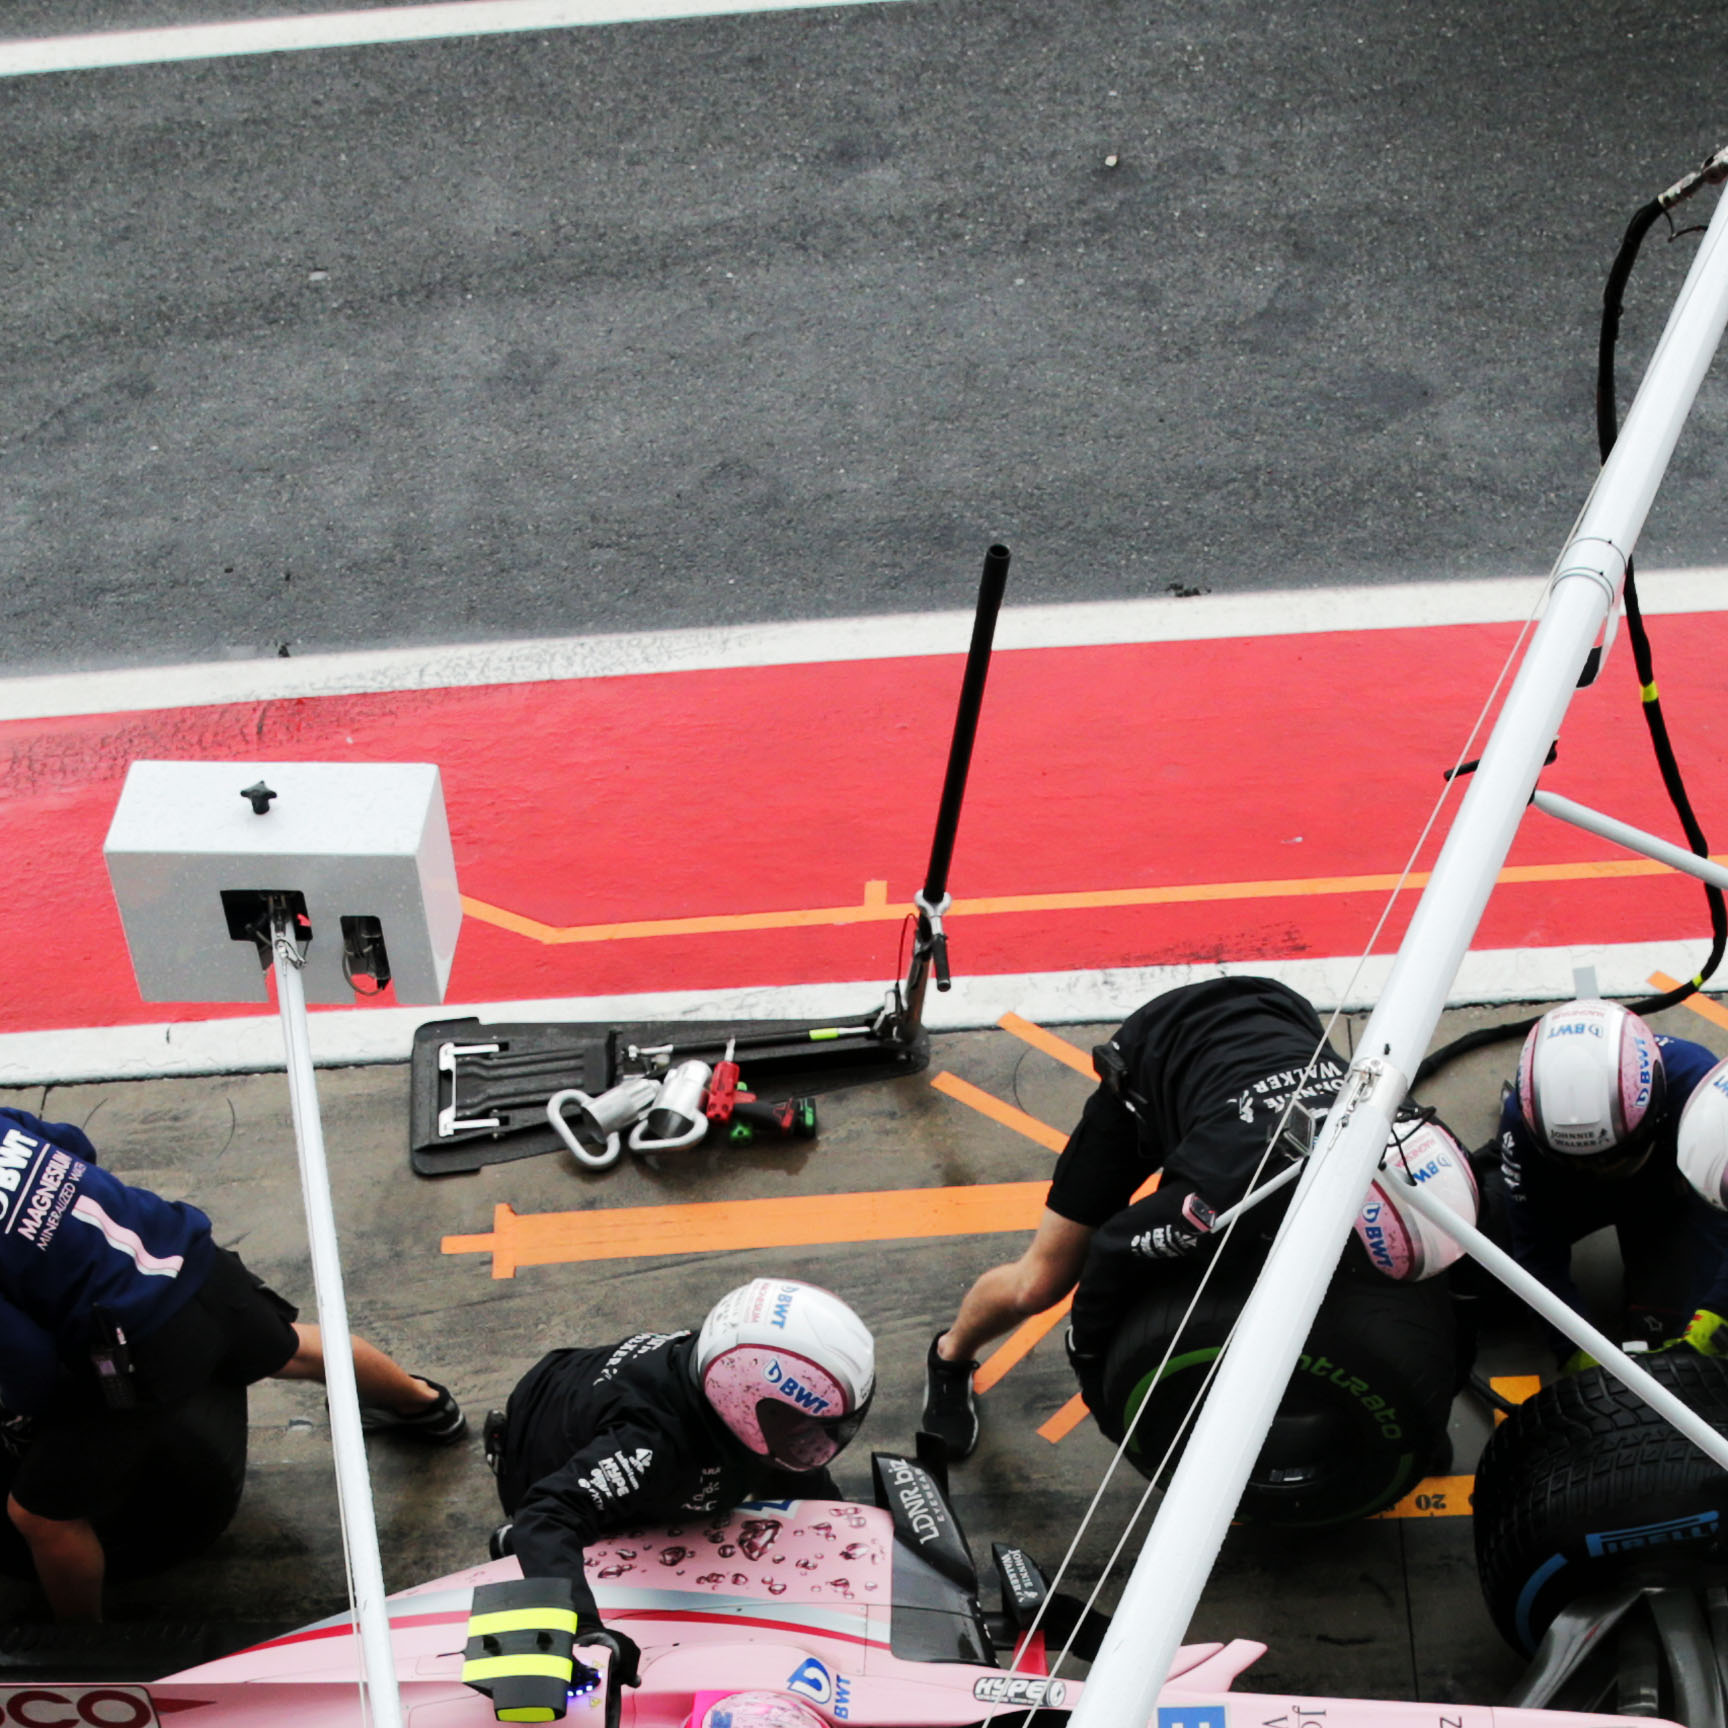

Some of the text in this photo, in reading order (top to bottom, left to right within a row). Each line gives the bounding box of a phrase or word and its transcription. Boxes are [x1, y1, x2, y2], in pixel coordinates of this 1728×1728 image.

[1547, 1023, 1585, 1038] BWT
[1634, 1037, 1650, 1084] BWT
[1550, 1129, 1594, 1139] JOHNNIE
[1554, 1139, 1597, 1147] WALKER
[17, 1151, 72, 1241] MAGNESIUM
[1365, 1227, 1391, 1269] BWT
[772, 1293, 792, 1329] BWT
[779, 1377, 831, 1415] BWT
[889, 1458, 939, 1544] LDNR.biz
[1415, 1493, 1447, 1510] 20
[1001, 1553, 1022, 1597] WALKER
[1009, 1549, 1032, 1589] JOHNNIE
[834, 1674, 851, 1719] BWT
[975, 1678, 1044, 1700] HYPE
